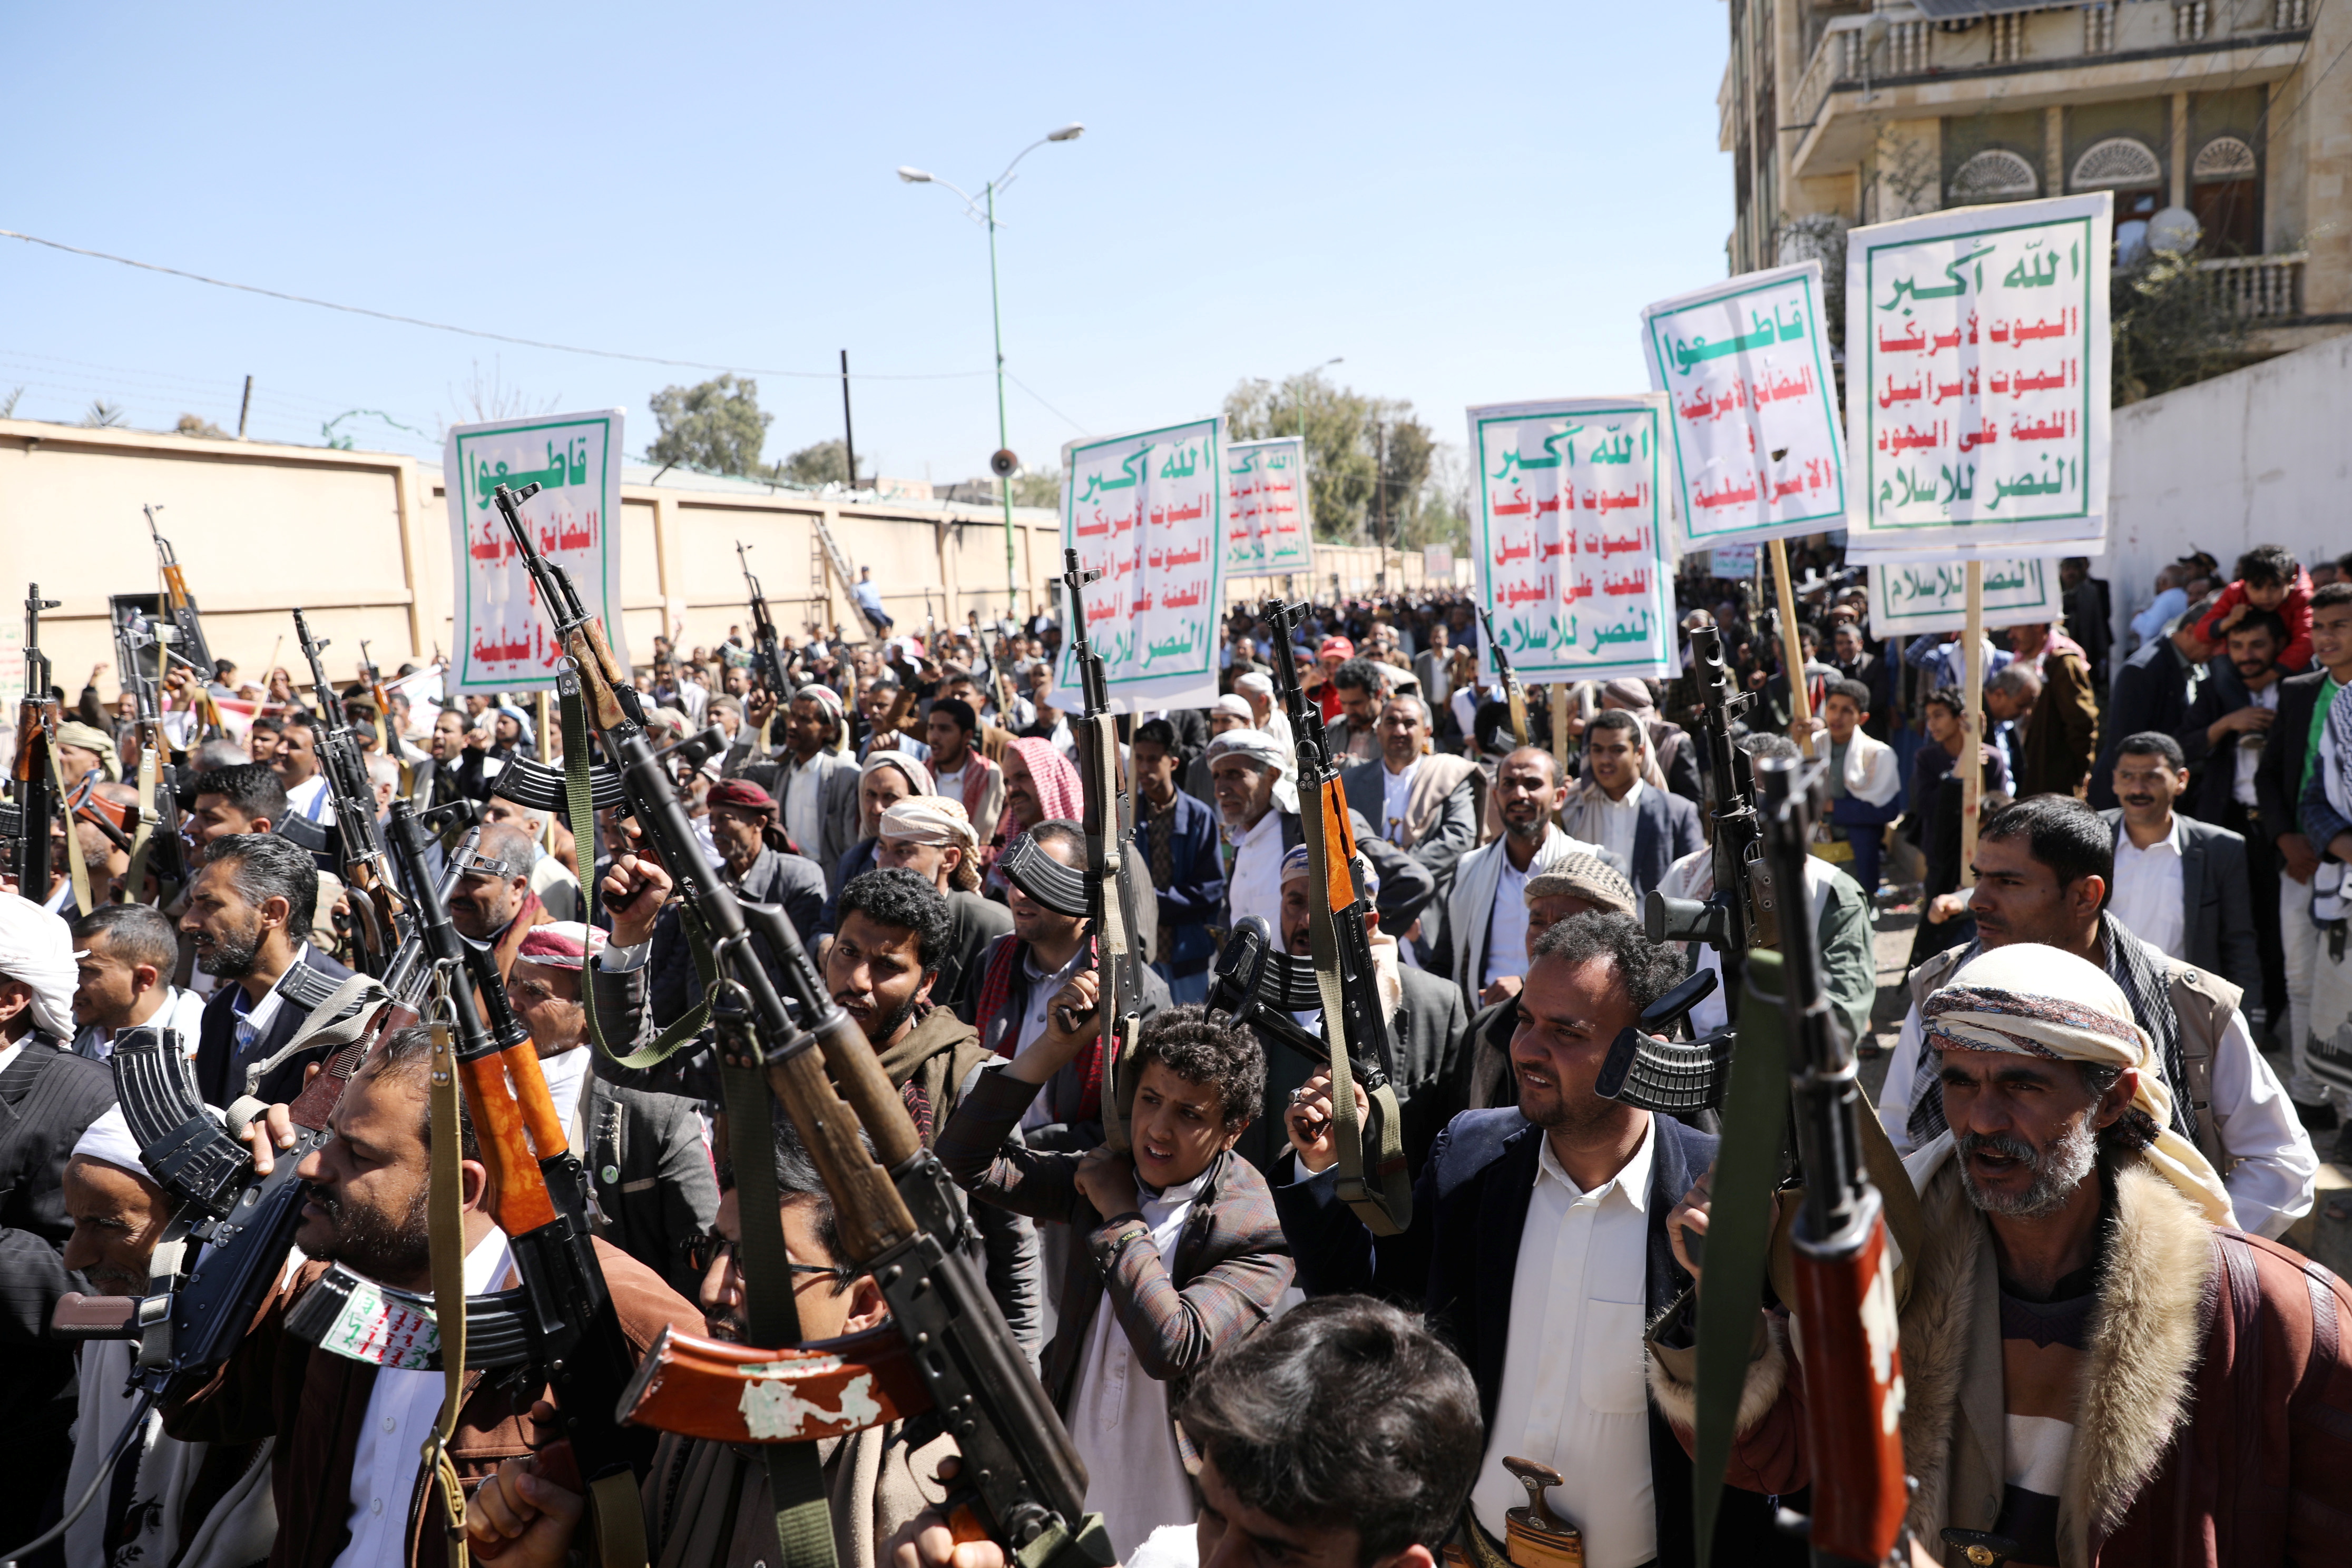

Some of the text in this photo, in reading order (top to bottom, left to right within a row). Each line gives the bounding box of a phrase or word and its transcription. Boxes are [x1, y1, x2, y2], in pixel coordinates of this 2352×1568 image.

[1877, 238, 2079, 316] الله أكبر
[1663, 299, 1804, 377] قاطعوا
[1879, 306, 2077, 357] الموت لأمريكا
[1677, 364, 1813, 426] البضائع الأمريكية
[1879, 358, 2077, 408] الموت لإسرائيل
[1489, 420, 1648, 484] الله أكبر
[1748, 425, 1755, 454] و
[1878, 409, 2076, 457] اللعنة على اليهود
[470, 437, 586, 510] قاطعوا
[1076, 436, 1210, 505] الله أكبر
[1267, 450, 1294, 468] الله
[1264, 478, 1296, 494] الموت
[1493, 478, 1648, 520] الموت لأمريكا
[1693, 457, 1831, 513] الإسرائيلية
[1879, 453, 2075, 516] النصر للإسلام
[1076, 493, 1209, 540] الموت لأمريكا
[1230, 518, 1300, 543] اللعنة على اليهو
[1267, 501, 1298, 516] الموت
[540, 509, 597, 562] البضائع
[1149, 536, 1209, 572] الموت
[1271, 537, 1302, 562] النصر
[1495, 526, 1651, 566] الموت لإسرائيل
[1086, 580, 1207, 628] اللعنة على اليهو
[1496, 567, 1652, 609] اللعنة على اليهود
[1892, 559, 2035, 606] النص للإسلام
[1140, 618, 1203, 669] النصر
[1497, 605, 1657, 660] النصر للإسلام
[342, 1311, 365, 1349] أكبر
[375, 1298, 394, 1326] الموت
[391, 1305, 410, 1332] الموت
[407, 1311, 426, 1332] اللعنة
[403, 1334, 414, 1347] على
[403, 1345, 428, 1369] للإسلا
